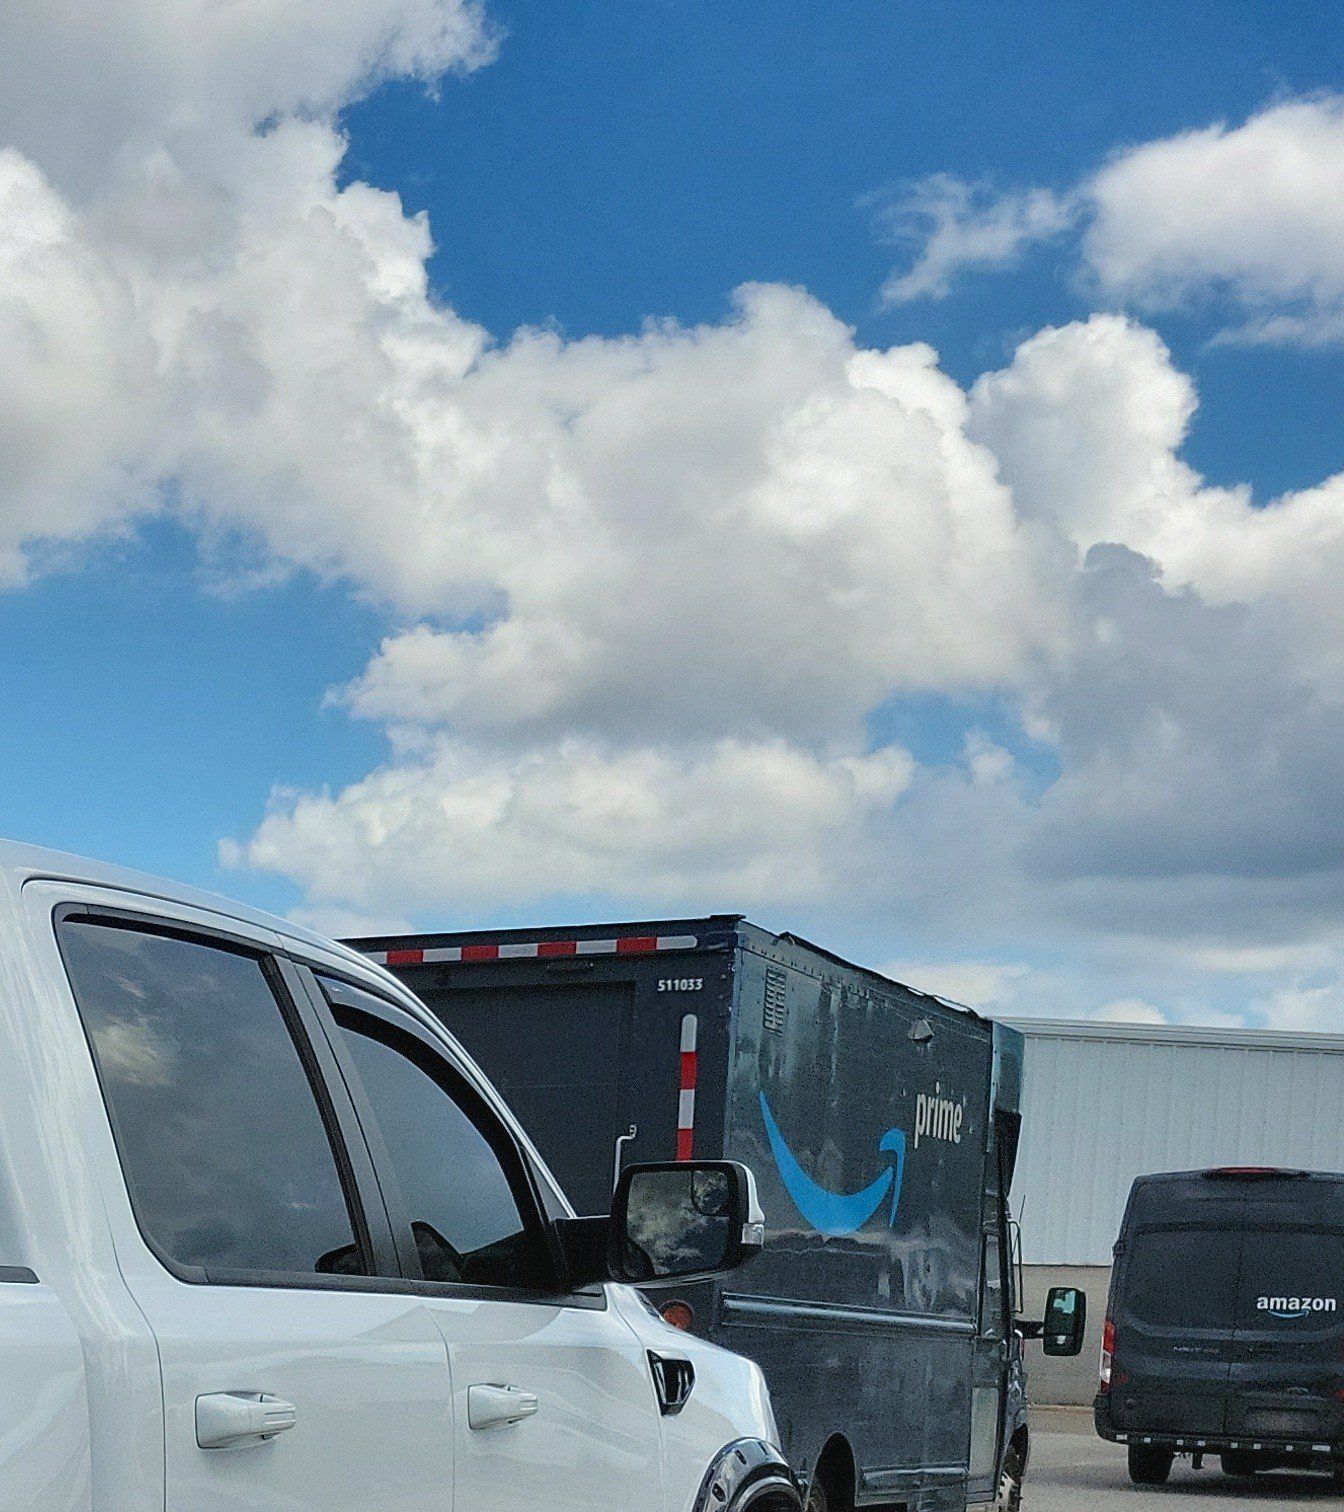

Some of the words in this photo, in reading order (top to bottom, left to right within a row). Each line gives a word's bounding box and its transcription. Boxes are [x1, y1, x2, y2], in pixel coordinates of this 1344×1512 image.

[657, 977, 703, 992] 511033
[914, 1081, 962, 1148] prime
[1256, 1296, 1337, 1312] amazon
